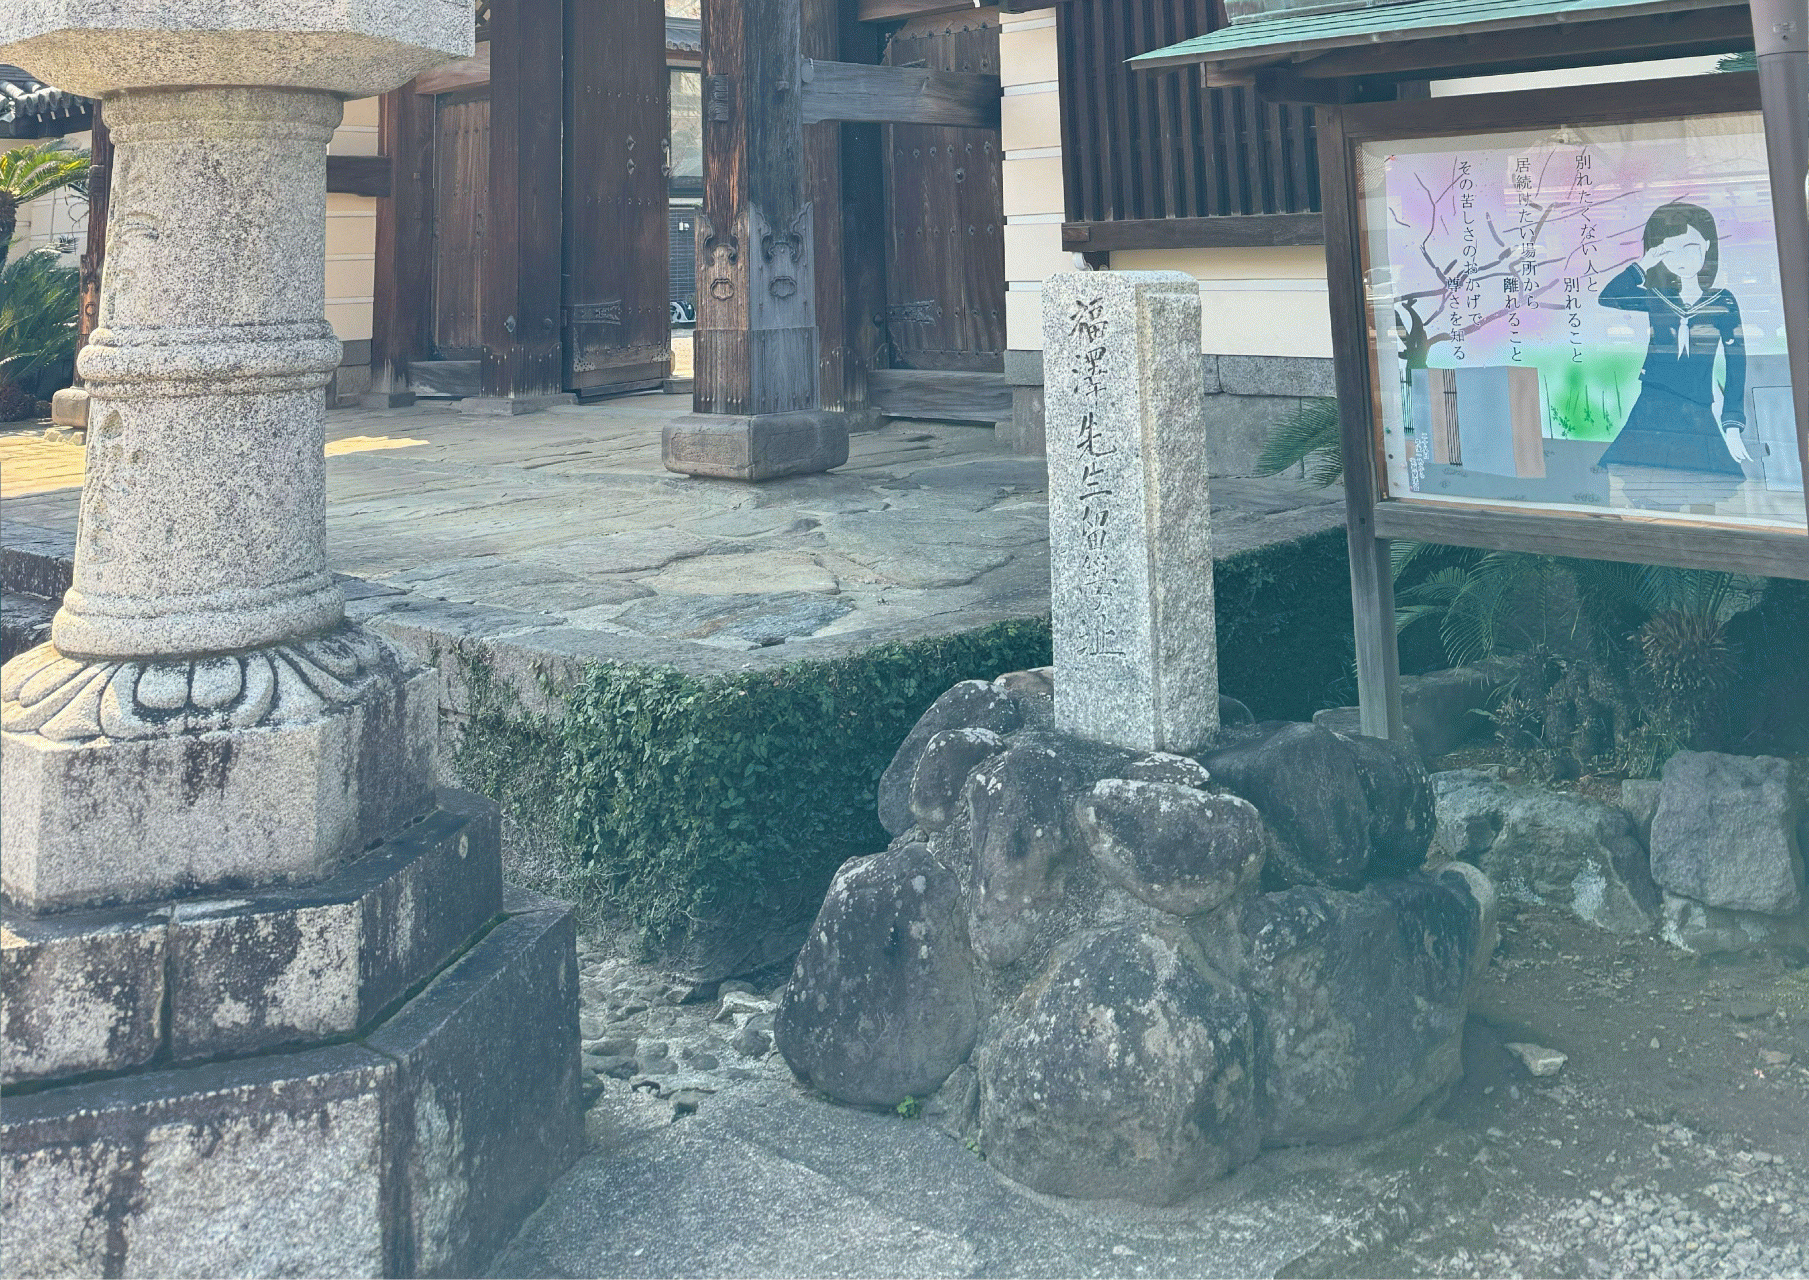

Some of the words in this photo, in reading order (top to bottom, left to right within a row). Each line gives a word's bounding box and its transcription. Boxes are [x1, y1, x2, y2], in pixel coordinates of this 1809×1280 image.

[1458, 160, 1482, 326] その苦しさのおかげで
[1515, 157, 1540, 310] 居続けたい場所から
[1575, 154, 1599, 292] 別れたくない人と
[1446, 277, 1465, 361] 尊さを知る
[1503, 277, 1522, 362] 離れること
[1563, 277, 1583, 363] 別れること
